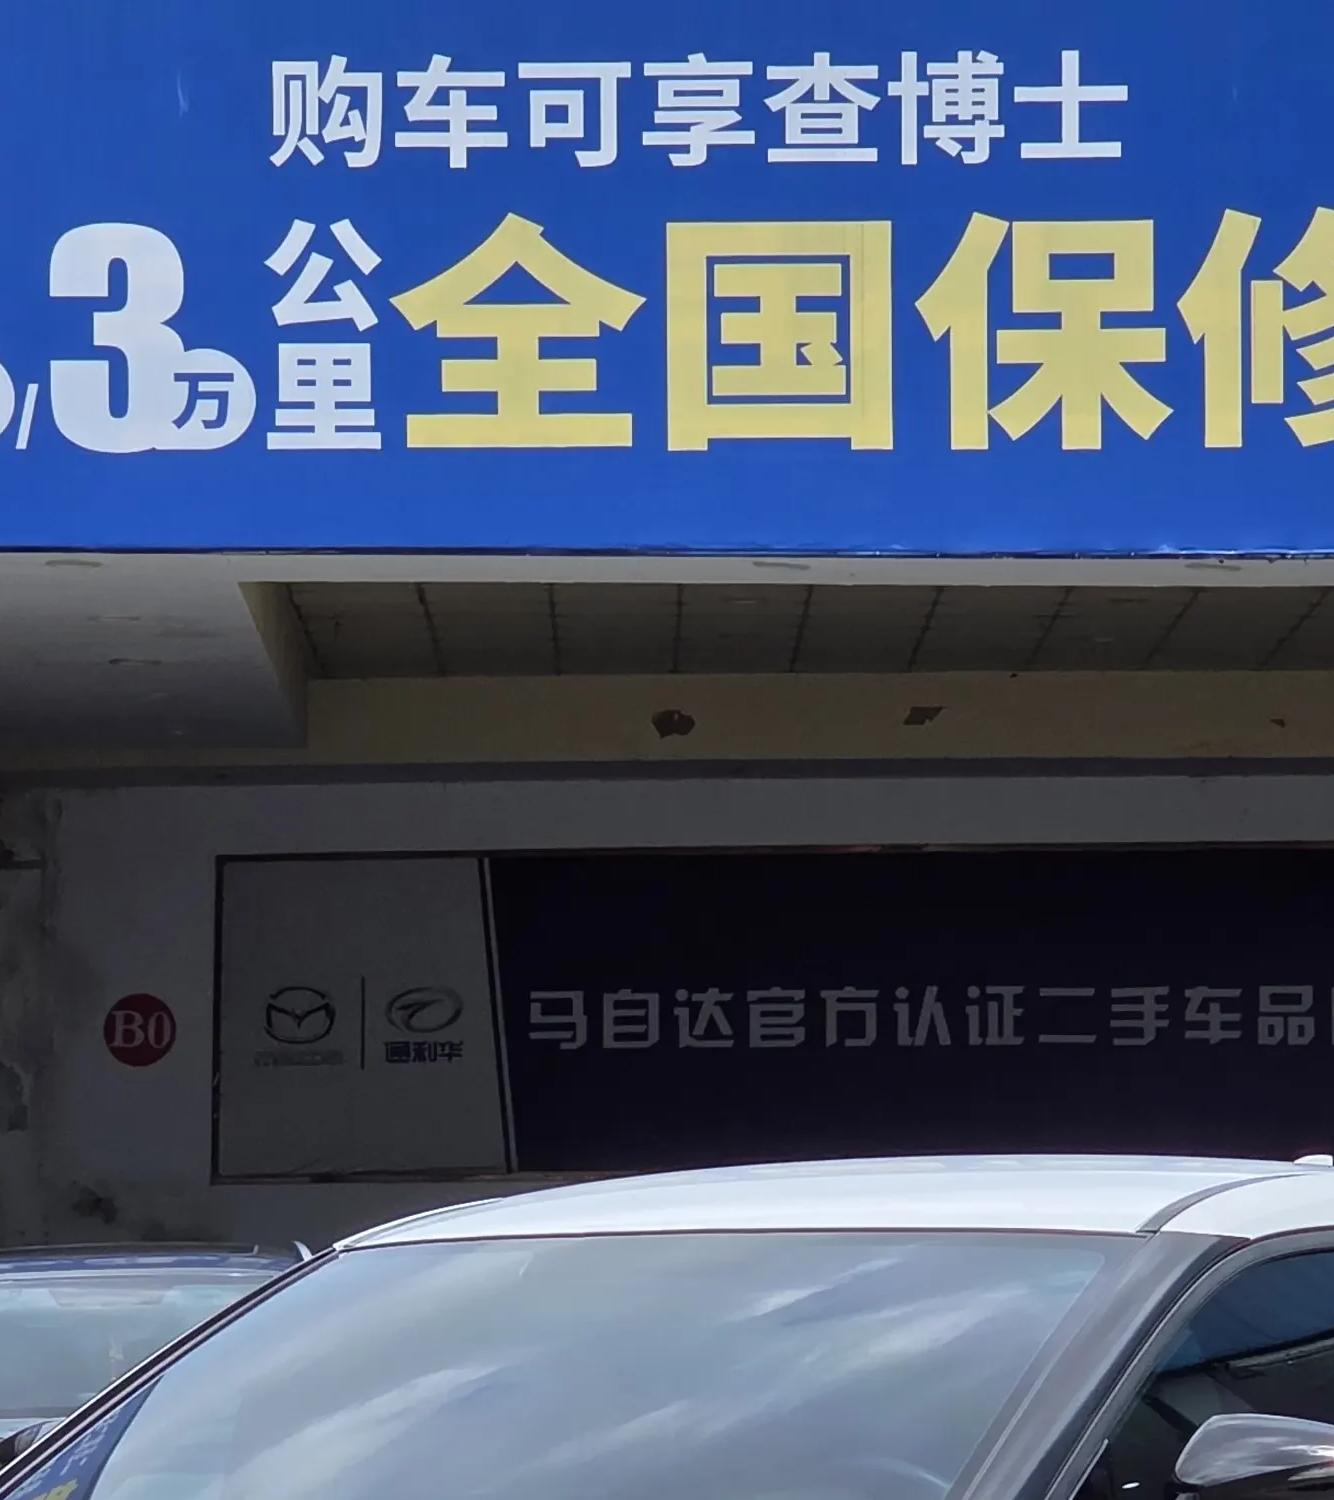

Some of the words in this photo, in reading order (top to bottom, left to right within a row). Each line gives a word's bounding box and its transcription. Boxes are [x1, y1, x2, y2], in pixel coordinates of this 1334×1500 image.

[268, 49, 1130, 169] 购车可享查博士
